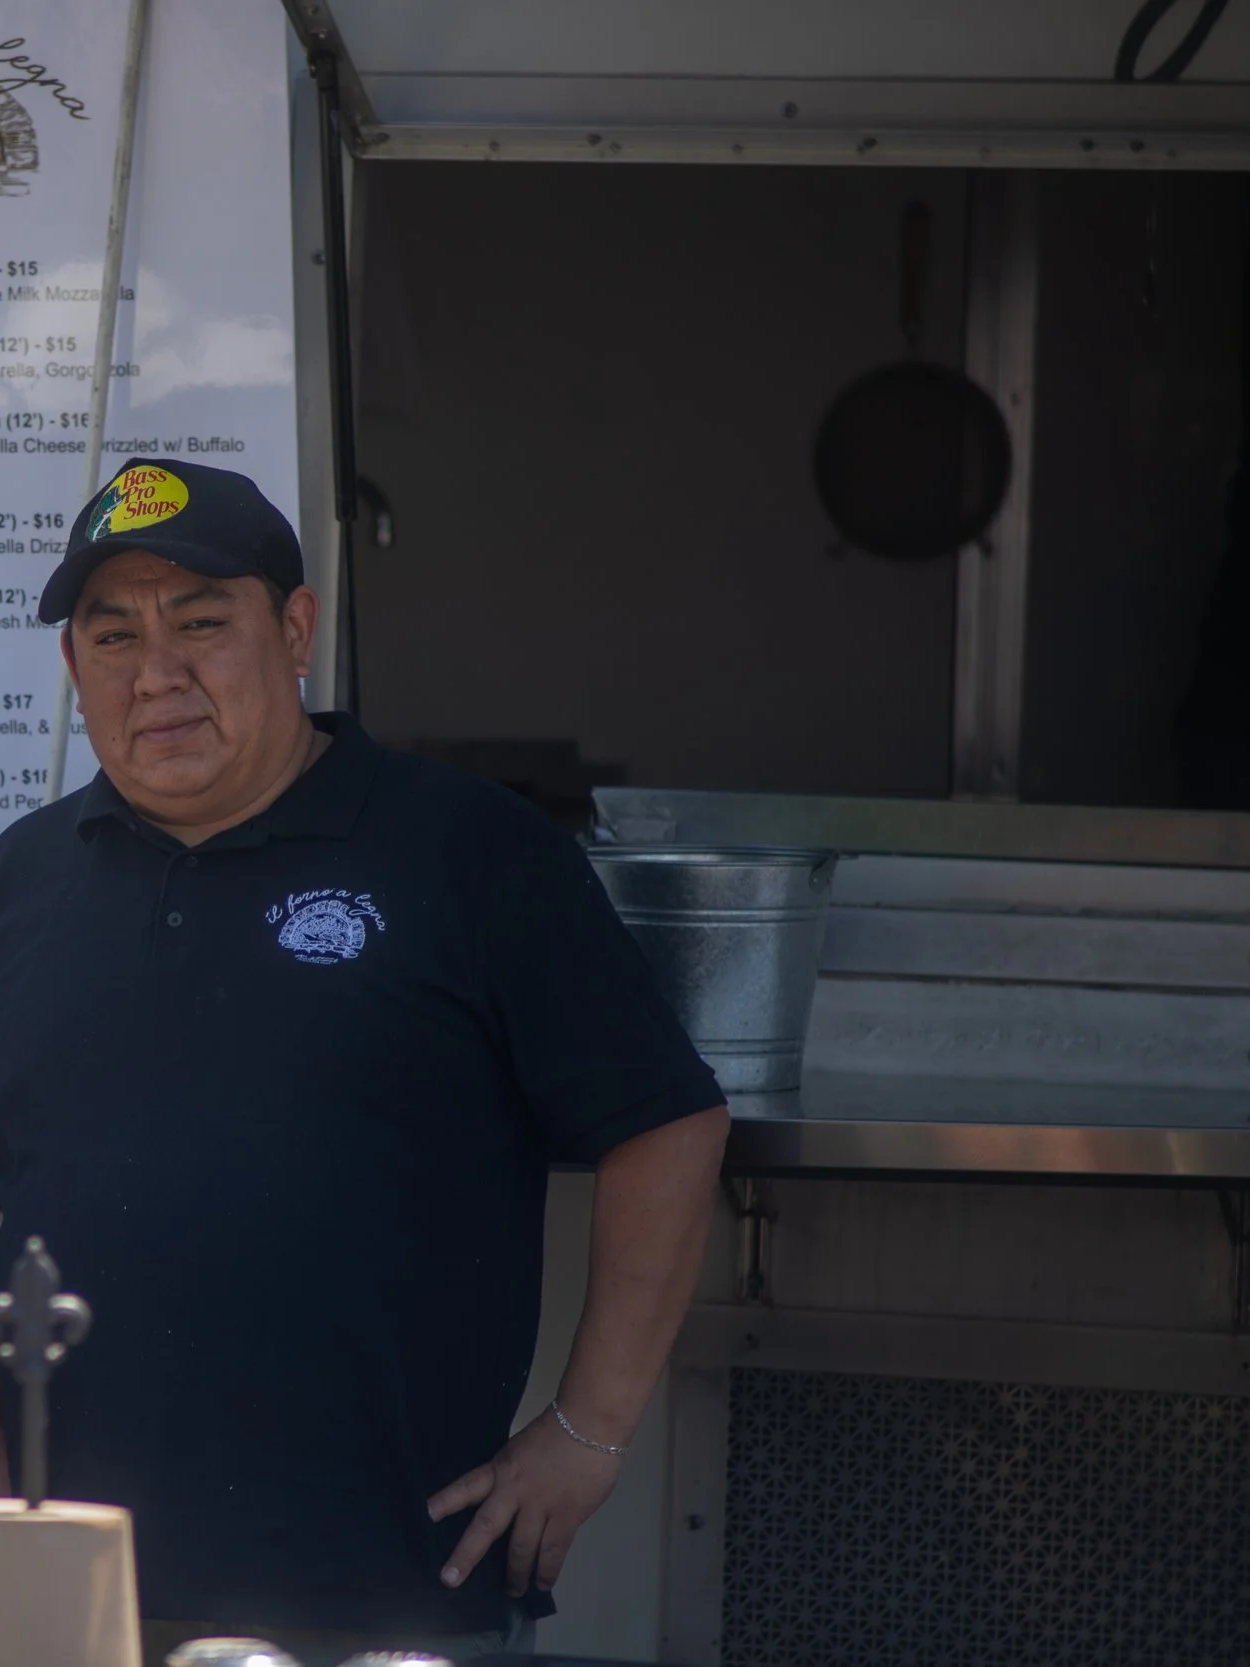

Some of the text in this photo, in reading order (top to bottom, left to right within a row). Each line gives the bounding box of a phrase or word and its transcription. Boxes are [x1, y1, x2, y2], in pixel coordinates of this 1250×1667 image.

[7, 260, 38, 278] $15
[7, 286, 39, 301] Milk
[46, 285, 135, 301] Mozzala
[46, 336, 77, 353] $15
[45, 361, 140, 381] Gorgozola
[23, 437, 86, 454] Cheese
[101, 437, 158, 453] rizzled
[163, 436, 183, 453] w/
[187, 437, 245, 453] Buffalo
[123, 470, 167, 490] Bass
[124, 486, 156, 504] Pro
[124, 500, 180, 519] Shops
[33, 512, 64, 530] $16
[3, 693, 34, 711] $17
[38, 719, 50, 735] &
[287, 888, 334, 913] forno
[336, 889, 351, 897] a
[349, 894, 386, 931] legna
